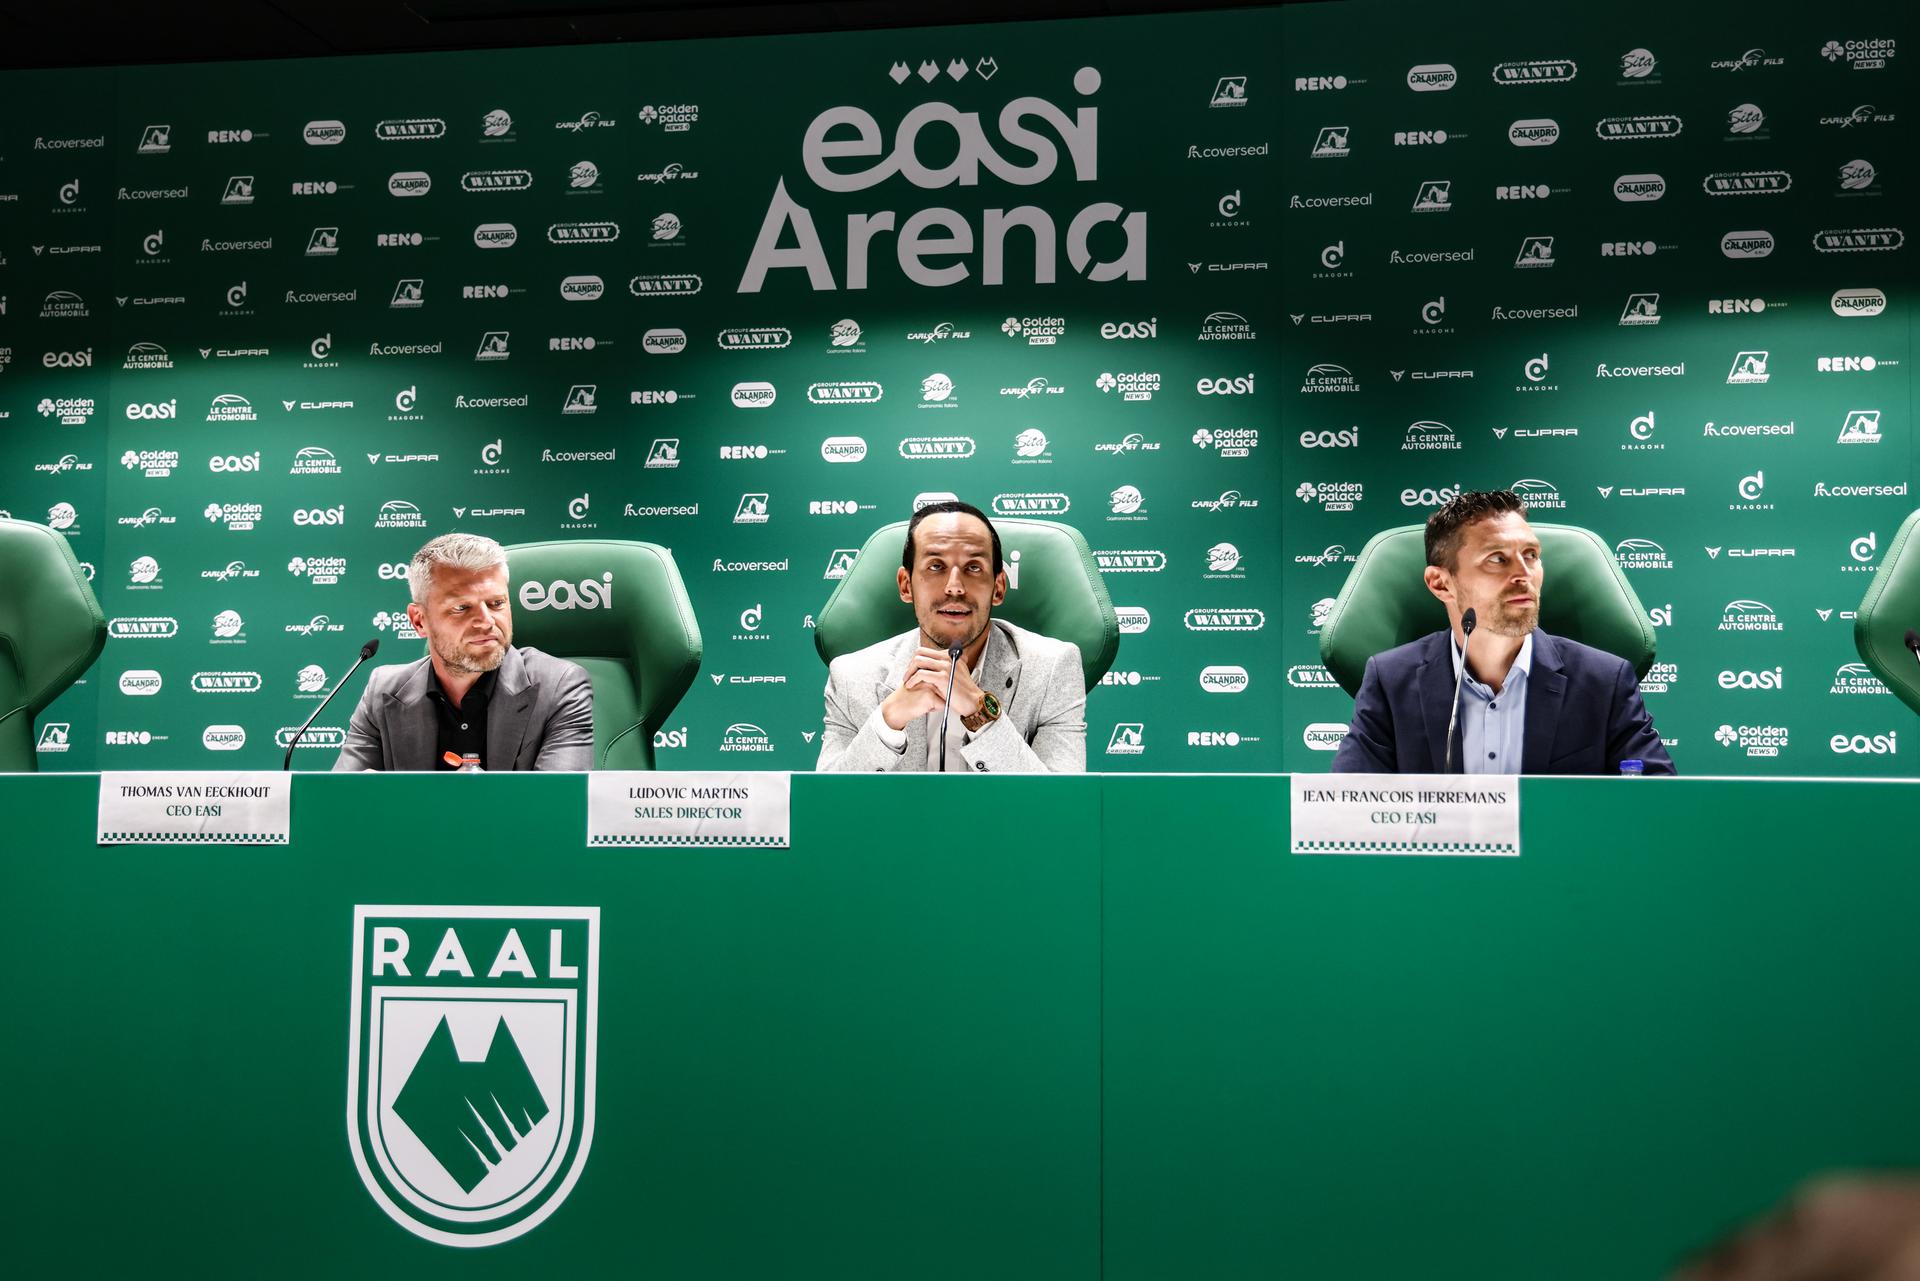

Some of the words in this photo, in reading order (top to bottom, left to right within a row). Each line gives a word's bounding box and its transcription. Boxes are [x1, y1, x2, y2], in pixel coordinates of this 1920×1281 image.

[1845, 39, 1895, 50] Golden
[1846, 49, 1895, 61] palace
[1503, 65, 1566, 78] WANTY
[658, 104, 698, 114] Golden
[659, 113, 698, 124] palace
[306, 128, 343, 138] CALANDRO
[384, 123, 437, 135] WANTY
[802, 66, 1102, 193] easi
[1512, 128, 1557, 138] CALANDRO
[1606, 120, 1671, 134] WANTY
[47, 135, 105, 149] coverseal
[1202, 142, 1269, 158] coverseal
[1617, 183, 1663, 193] CALANDRO
[1714, 176, 1781, 189] WANTY
[131, 186, 189, 200] coverseal
[477, 231, 515, 240] CALANDRO
[557, 226, 611, 238] WANTY
[736, 175, 1148, 293] Arena
[1824, 233, 1893, 246] WANTY
[49, 245, 102, 254] CUPRA
[1405, 248, 1474, 263] coverseal
[1208, 262, 1268, 271] CUPRA
[563, 284, 602, 293] CALANDRO
[638, 279, 693, 291] WANTY
[133, 296, 186, 305] CUPRA
[298, 289, 357, 303] coverseal
[1834, 298, 1884, 308] CALANDRO
[39, 309, 89, 318] AUTOMOBILE
[1310, 314, 1372, 323] CUPRA
[1100, 317, 1157, 340] easi
[646, 337, 684, 346] CALANDRO
[727, 332, 783, 344] WANTY
[1197, 332, 1256, 341] AUTOMOBILE
[383, 341, 442, 355] coverseal
[42, 347, 92, 368] easi
[122, 361, 174, 369] AUTOMOBILE
[1612, 362, 1685, 377] coverseal
[1117, 372, 1160, 383] Golden
[1117, 381, 1160, 392] palace
[1196, 372, 1255, 396] easi
[734, 390, 774, 400] CALANDRO
[816, 387, 874, 399] WANTY
[125, 398, 177, 420] easi
[300, 401, 354, 410] CUPRA
[205, 413, 257, 422] AUTOMOBILE
[1214, 429, 1258, 440] Golden
[1514, 428, 1579, 437] CUPRA
[1720, 421, 1795, 436] coverseal
[1299, 425, 1359, 449] easi
[824, 444, 865, 454] CALANDRO
[908, 442, 966, 454] WANTY
[1215, 438, 1258, 449] palace
[385, 454, 439, 463] CUPRA
[555, 448, 616, 462] coverseal
[208, 450, 261, 473] easi
[289, 466, 342, 475] AUTOMOBILE
[1619, 487, 1686, 497] CUPRA
[1831, 481, 1908, 497] coverseal
[223, 503, 262, 513] Golden
[638, 502, 699, 516] coverseal
[223, 512, 262, 523] palace
[292, 504, 345, 526] easi
[1727, 548, 1796, 557] CUPRA
[726, 558, 789, 572] coverseal
[519, 571, 613, 611] easi
[1194, 614, 1255, 626] WANTY
[1723, 614, 1733, 622] LE
[1736, 614, 1776, 622] CENTRE
[1717, 622, 1784, 631] AUTOMOBILE
[122, 678, 160, 688] CALANDRO
[200, 676, 253, 687] WANTY
[729, 675, 787, 684] CUPRA
[1203, 674, 1247, 684] CALANDRO
[1717, 666, 1783, 690] easi
[1739, 725, 1788, 737] Golden
[719, 743, 775, 752] AUTOMOBILE
[1739, 735, 1788, 748] palace
[1829, 730, 1897, 755] easi
[121, 786, 173, 798] THOMAS
[176, 786, 201, 798] VAN
[205, 786, 271, 798] EECKHOUT
[629, 787, 688, 799] LUDOVIC
[691, 787, 749, 800] MARTINS
[1303, 790, 1414, 803] JEAN-FRANCOIS
[1418, 791, 1507, 804] HERREMANS
[166, 805, 192, 817] CEO
[195, 805, 222, 817] EASI
[634, 806, 673, 818] SALES
[677, 807, 742, 819] DIRECTOR
[1370, 811, 1401, 825] CEO
[1406, 811, 1437, 825] EASI
[372, 926, 579, 979] RAAL
